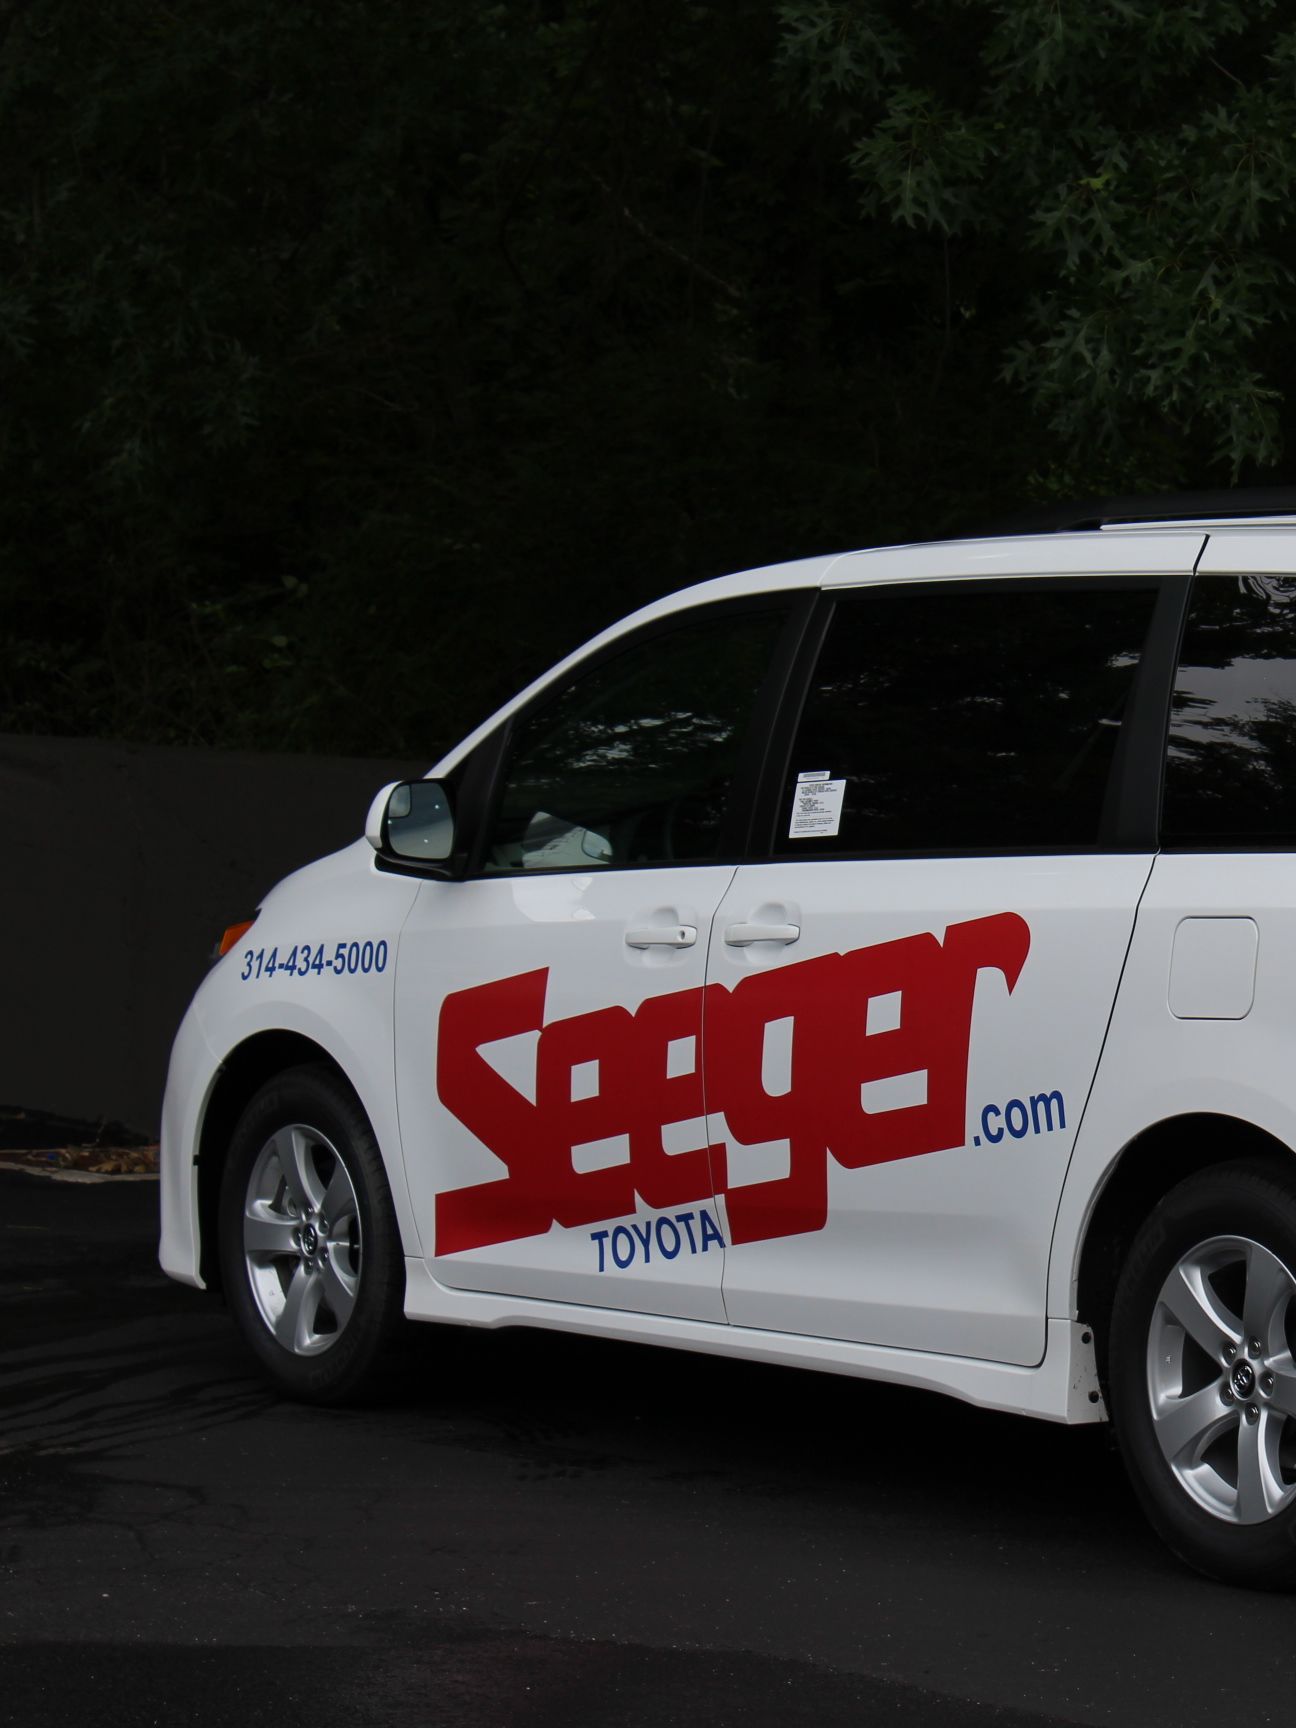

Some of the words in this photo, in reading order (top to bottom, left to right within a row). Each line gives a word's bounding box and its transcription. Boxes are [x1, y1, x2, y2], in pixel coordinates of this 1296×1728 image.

[241, 940, 389, 981] 314-434-5000
[435, 911, 1031, 1257] Seeger
[590, 1210, 726, 1273] TOYOTA
